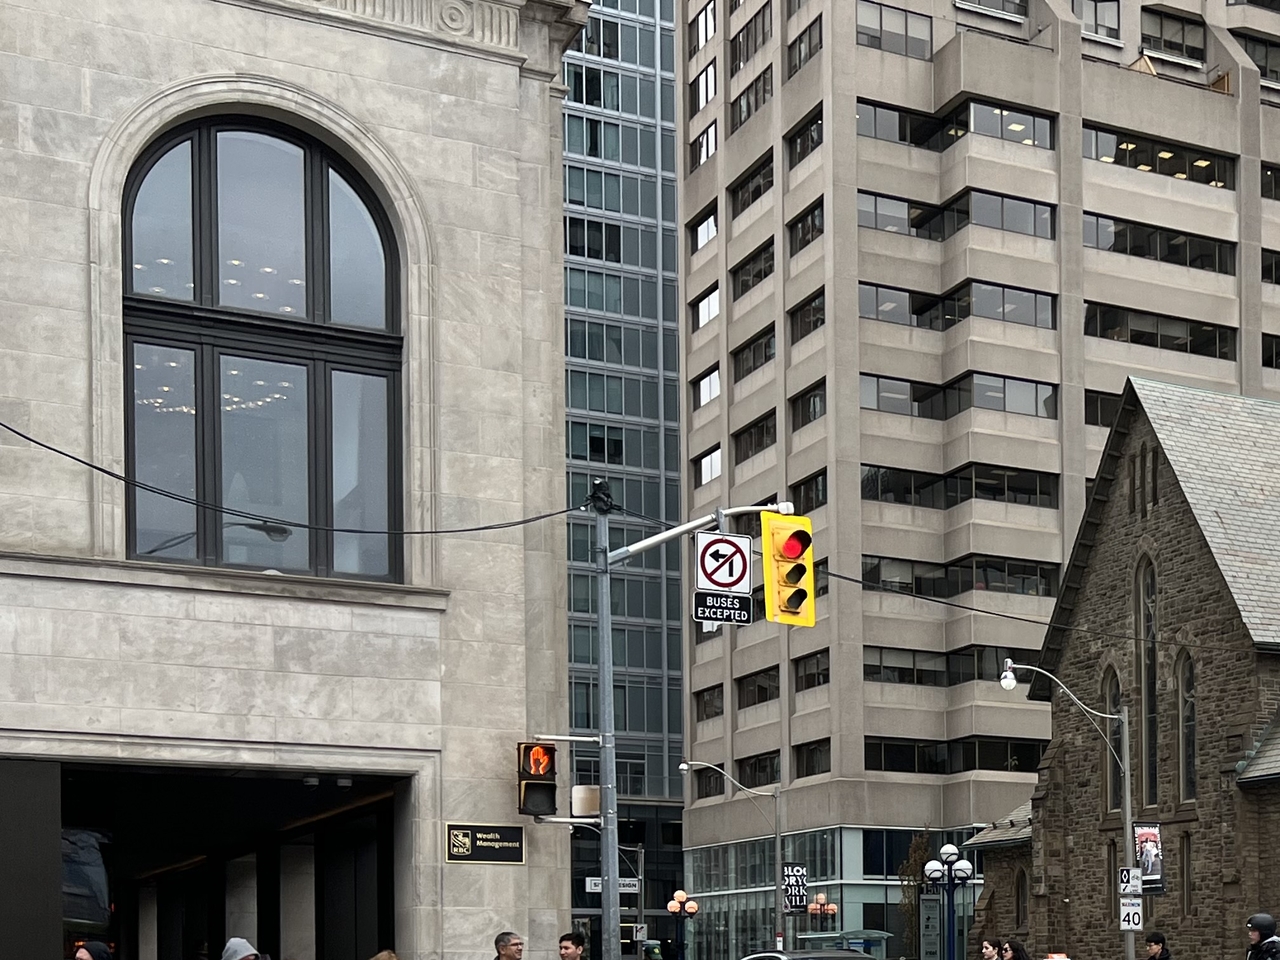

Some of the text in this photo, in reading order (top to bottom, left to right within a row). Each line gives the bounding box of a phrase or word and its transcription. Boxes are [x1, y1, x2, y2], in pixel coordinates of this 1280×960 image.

[706, 596, 740, 609] BUSES
[697, 607, 748, 621] EXCEPTED
[476, 840, 520, 849] Management
[921, 884, 940, 894] 150
[1122, 911, 1141, 926] 40
